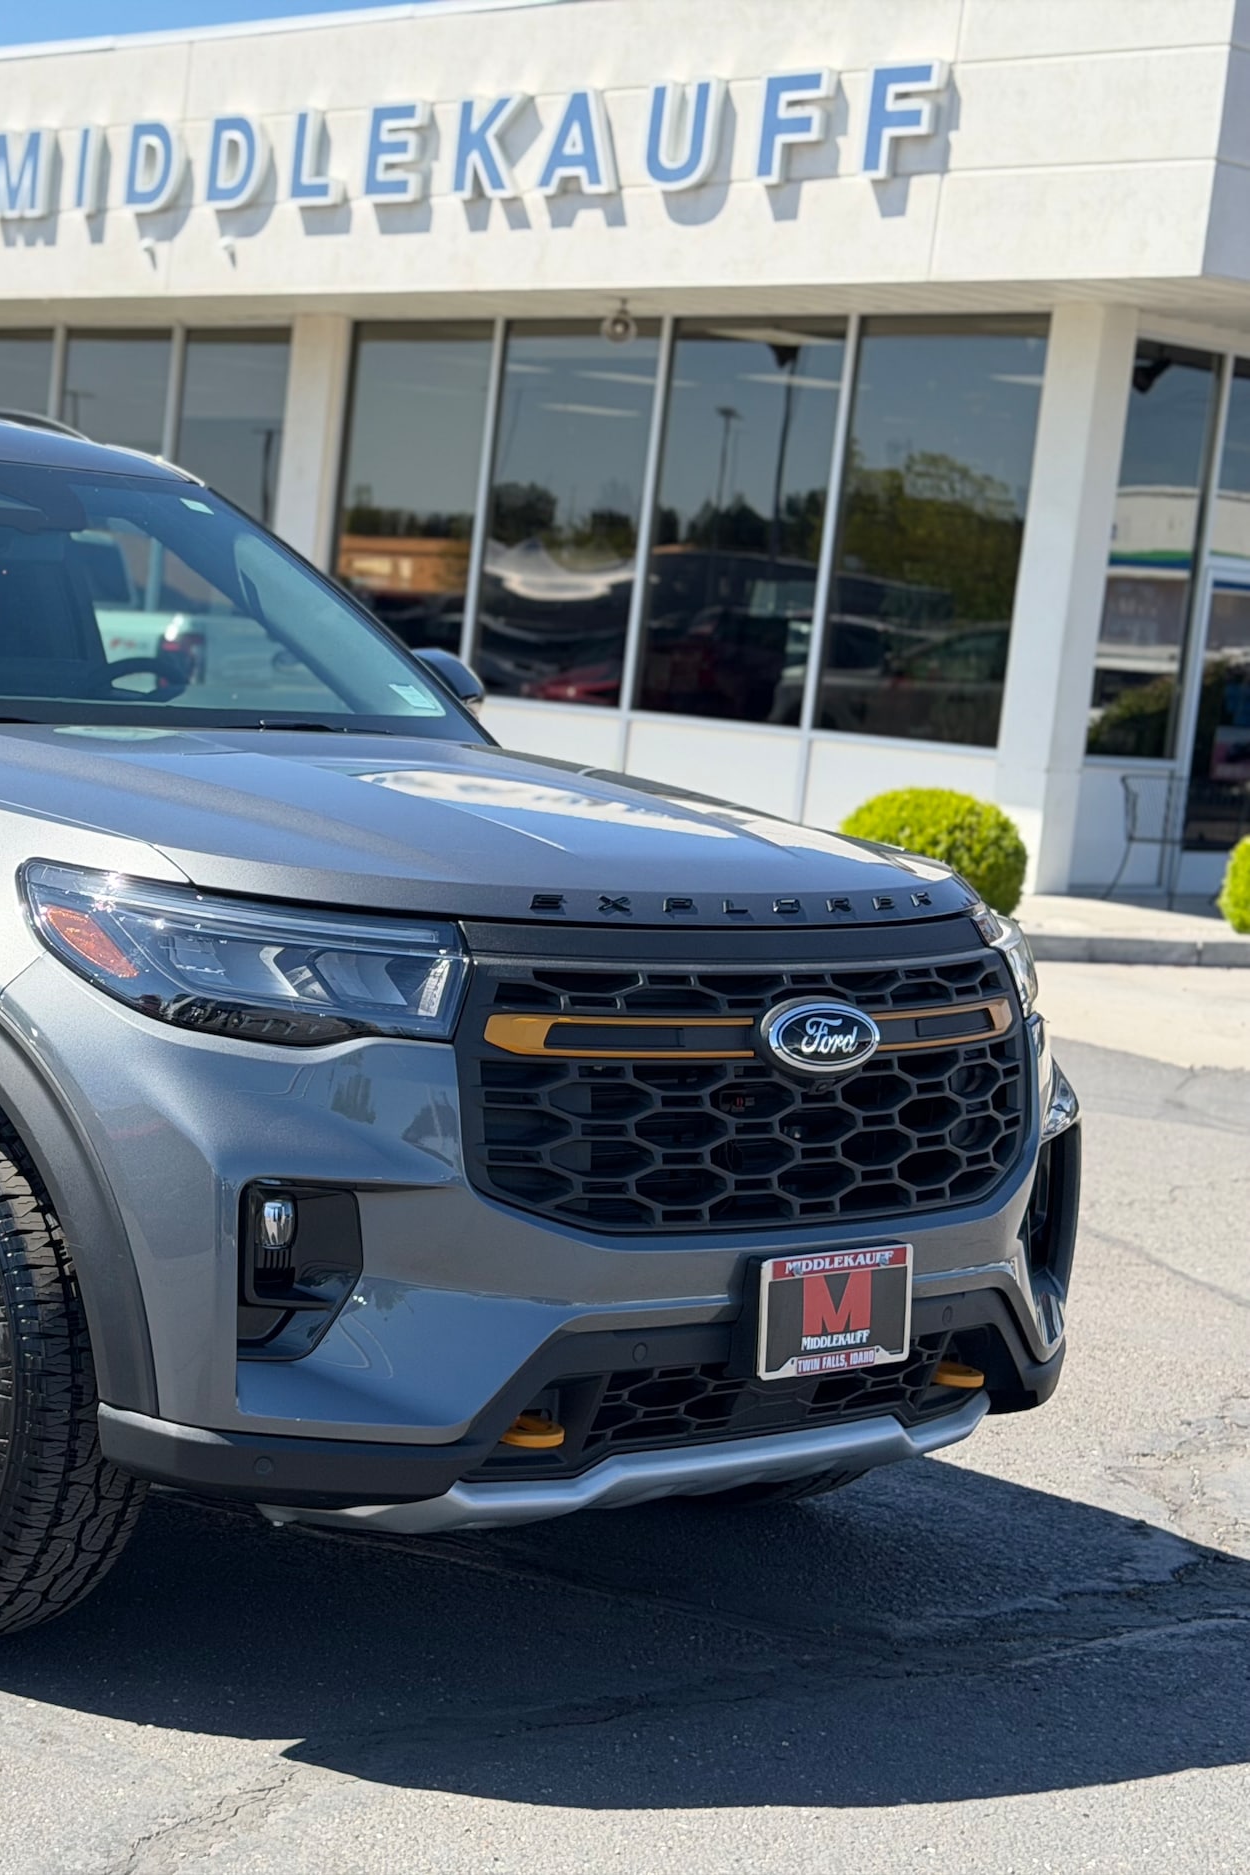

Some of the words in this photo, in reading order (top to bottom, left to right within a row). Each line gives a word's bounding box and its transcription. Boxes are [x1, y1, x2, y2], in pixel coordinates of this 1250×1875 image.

[530, 891, 932, 914] EXPLORER
[800, 1016, 859, 1055] Ford
[802, 1269, 872, 1336] M
[801, 1329, 870, 1351] MIDDLEKAUFF
[797, 1357, 821, 1373] TWIN
[821, 1354, 848, 1369] FALLS,
[849, 1349, 874, 1366] IDAHO
